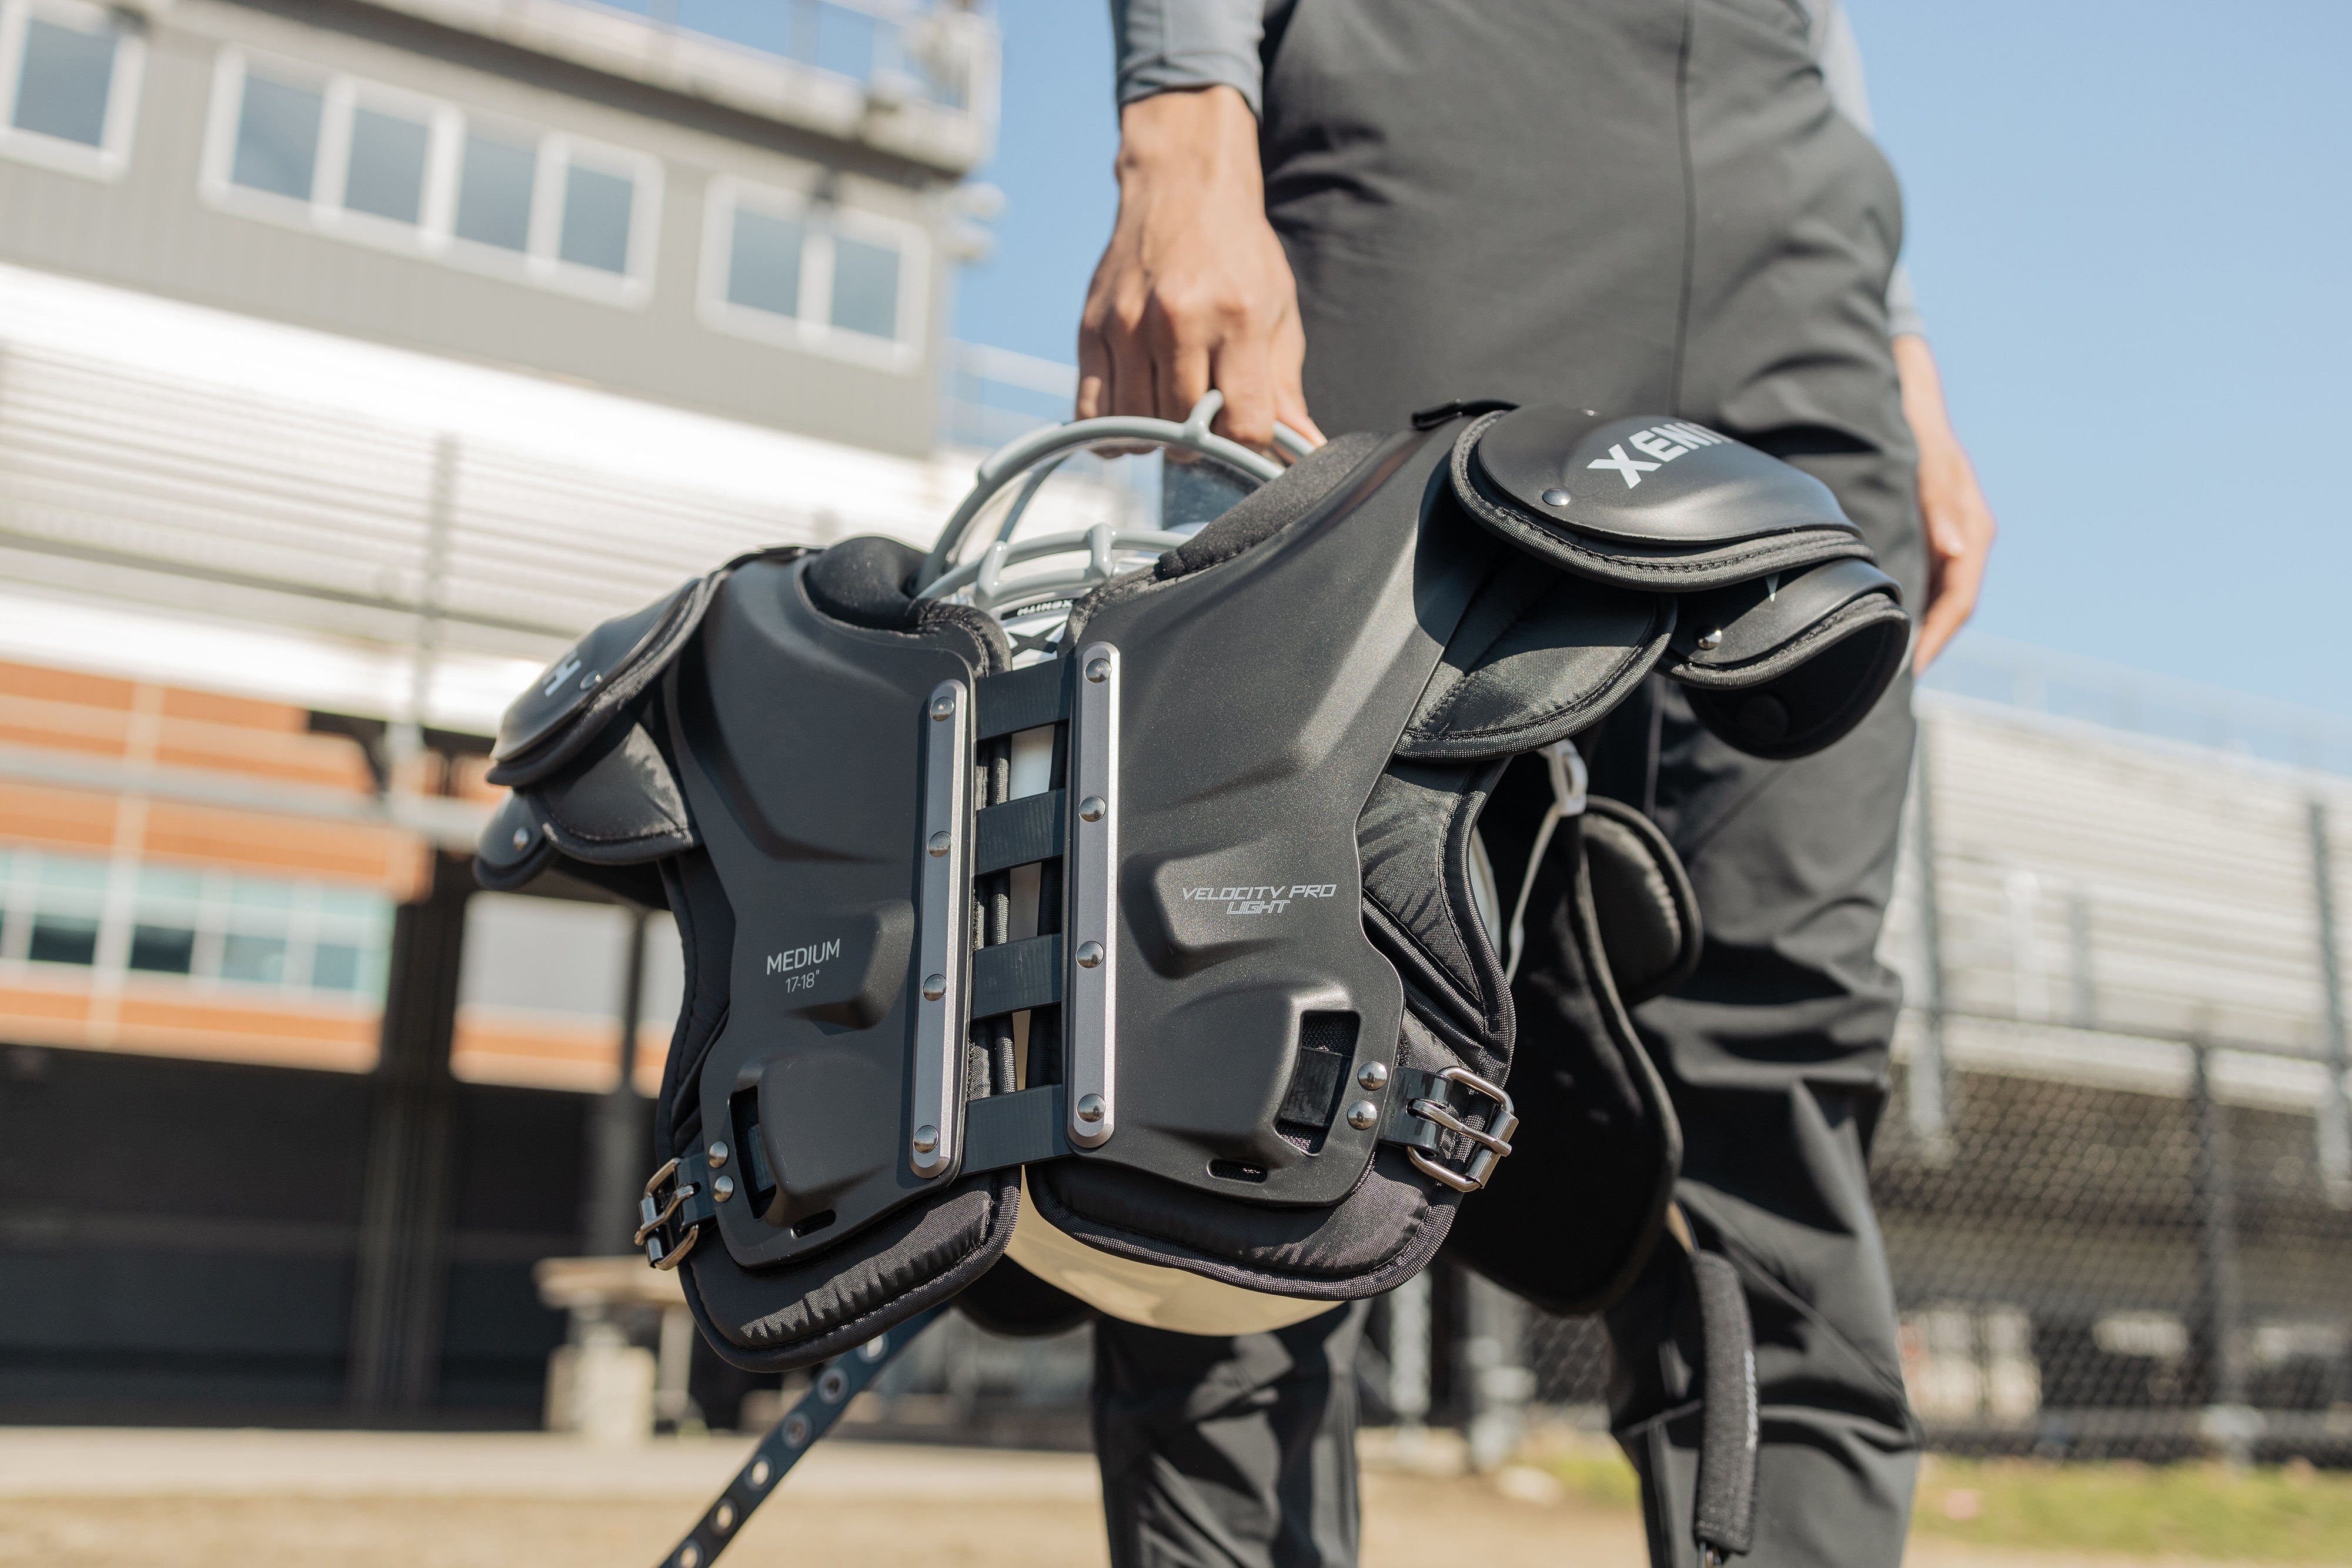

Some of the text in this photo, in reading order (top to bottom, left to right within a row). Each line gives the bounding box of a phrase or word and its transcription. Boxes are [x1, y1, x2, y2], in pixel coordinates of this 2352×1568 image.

[1017, 599, 1074, 616] XENITH
[1181, 884, 1337, 901] VELOCITY PRO
[1227, 900, 1291, 914] LIGHT
[766, 938, 840, 975] MEDIUM
[785, 969, 820, 993] 17-18"
